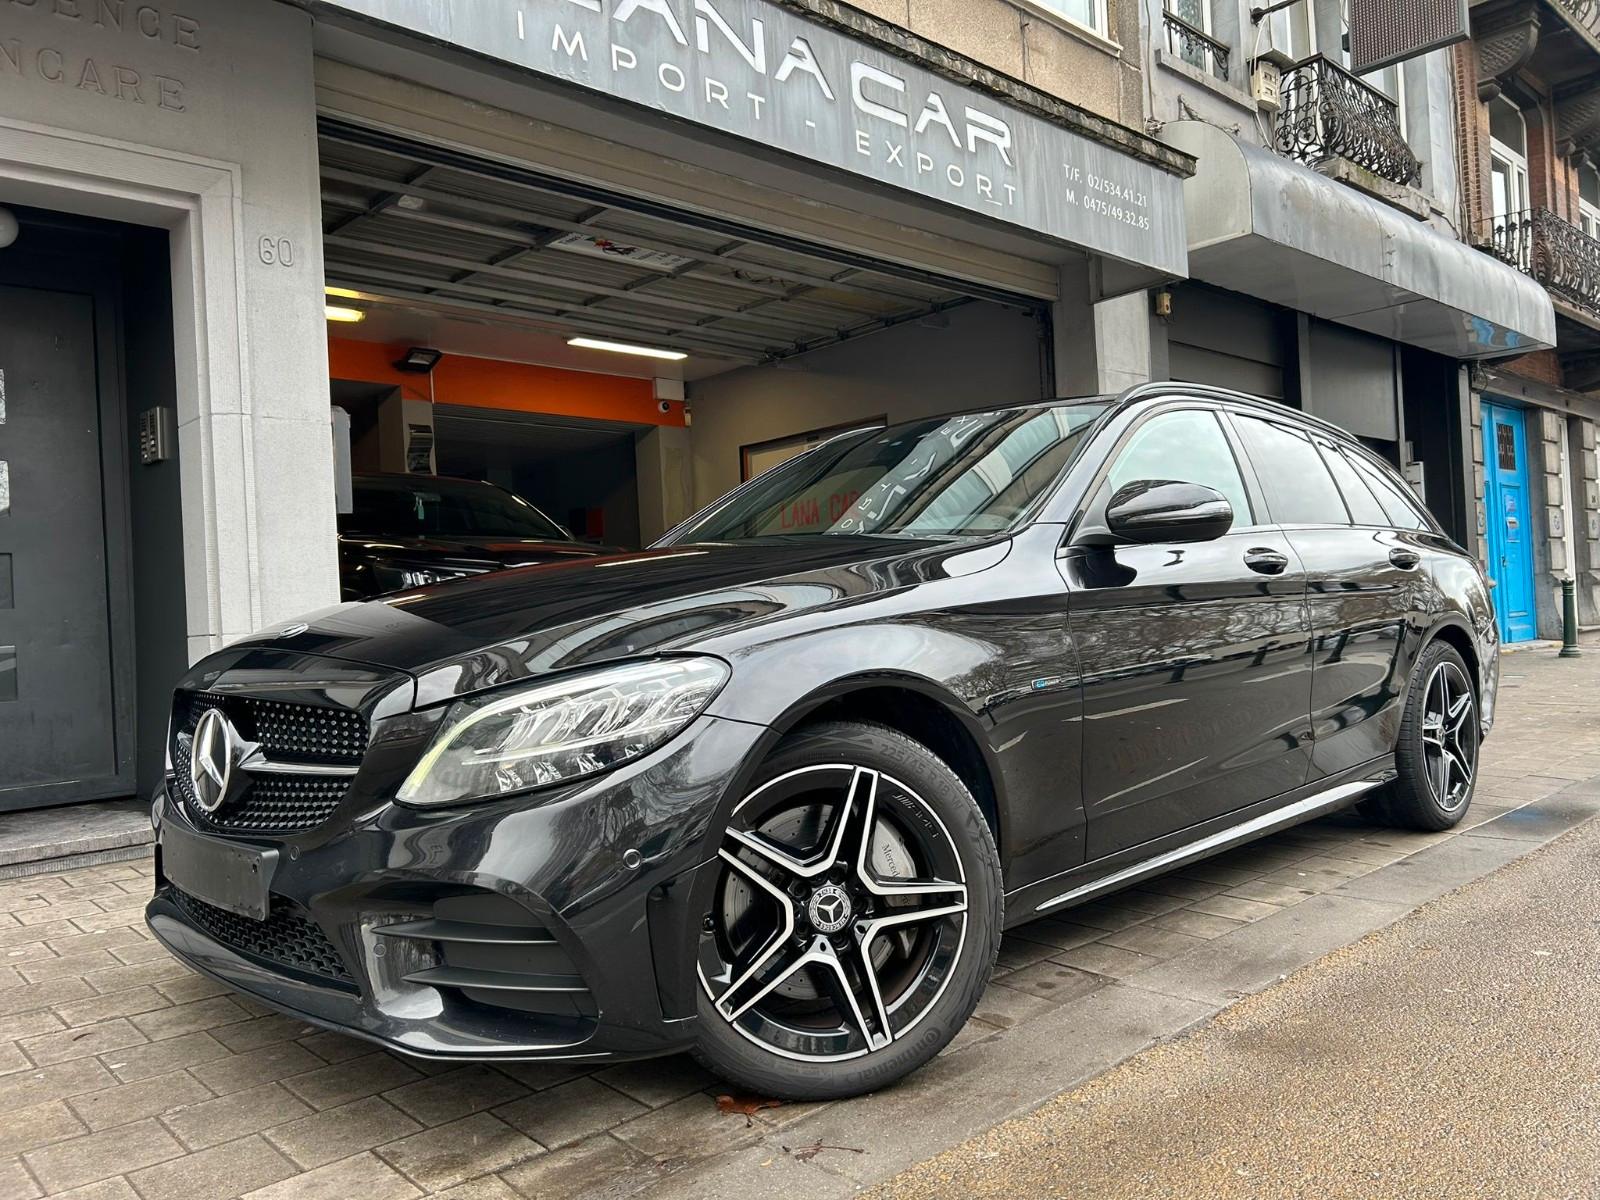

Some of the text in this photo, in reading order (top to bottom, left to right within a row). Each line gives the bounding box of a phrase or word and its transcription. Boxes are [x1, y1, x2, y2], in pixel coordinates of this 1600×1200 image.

[9, 0, 201, 52] ENCE
[516, 10, 766, 120] IMPORT
[855, 129, 1017, 206] EXPORT
[1063, 163, 1147, 208] T/F. 02/534.41.21
[1066, 188, 1149, 231] M. 0475/49.32.85
[258, 233, 295, 267] 60
